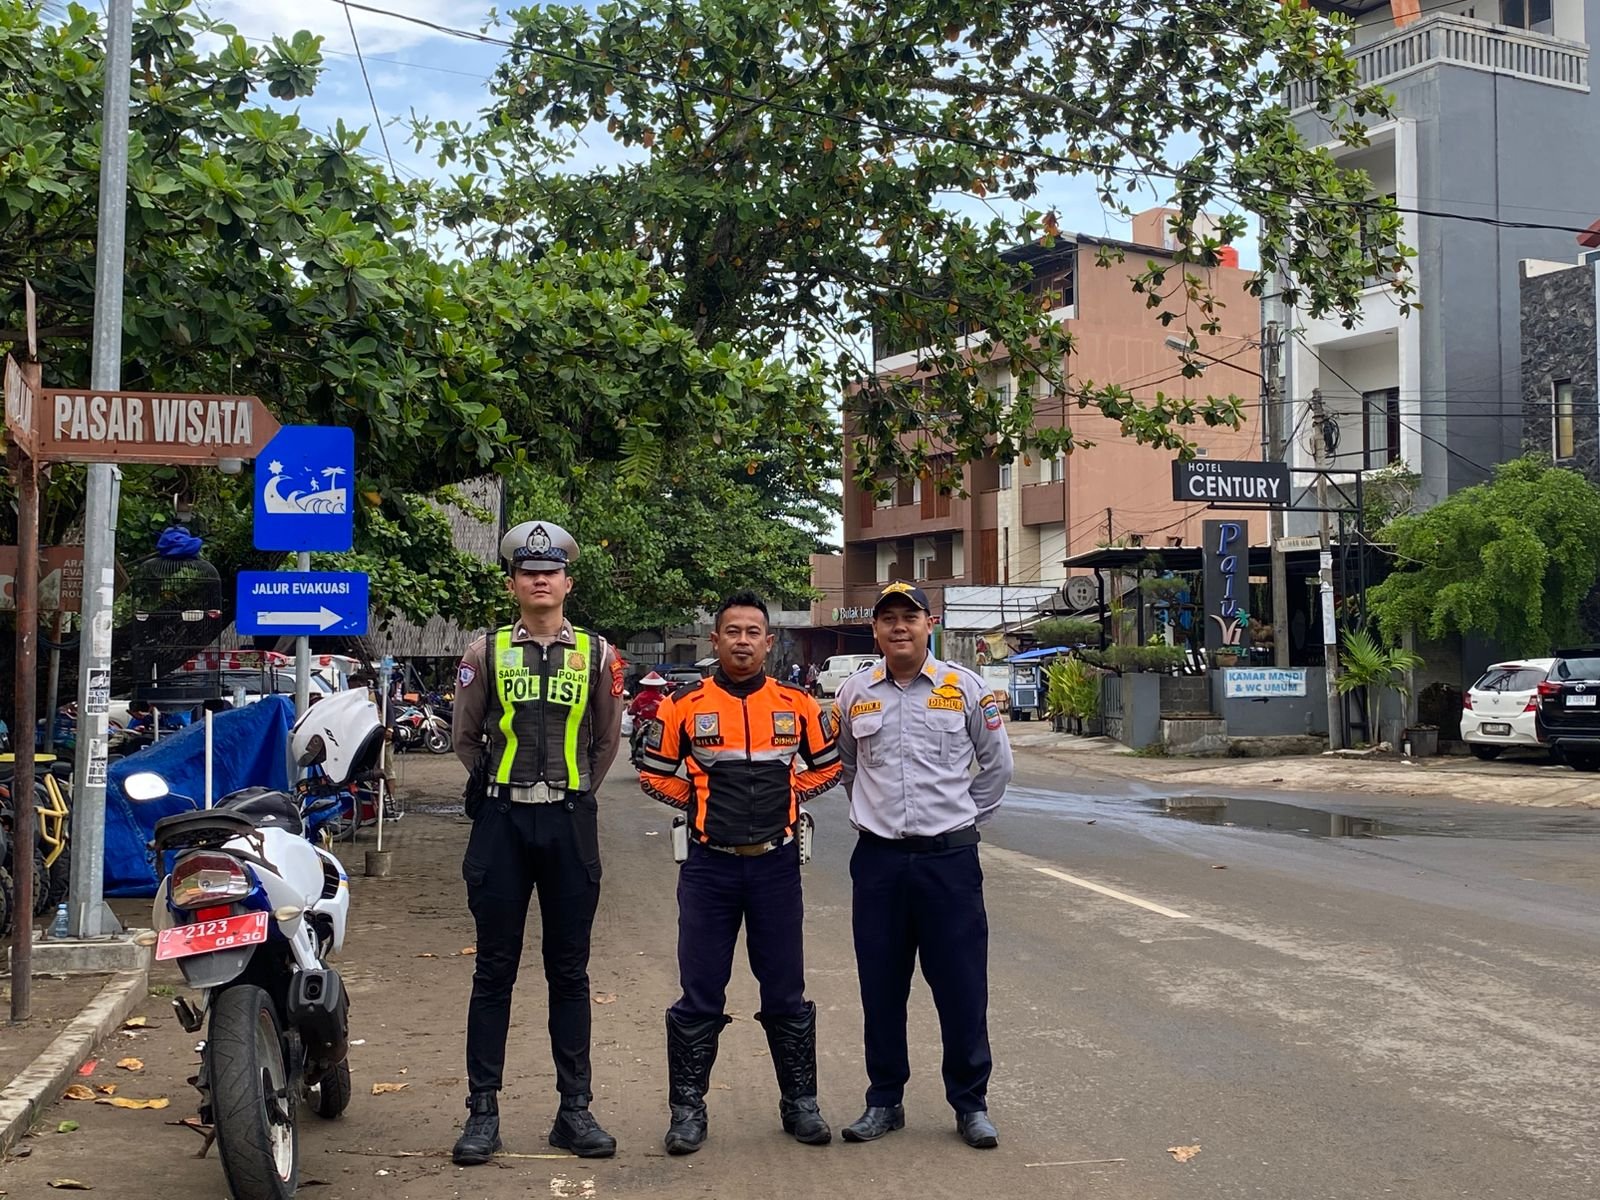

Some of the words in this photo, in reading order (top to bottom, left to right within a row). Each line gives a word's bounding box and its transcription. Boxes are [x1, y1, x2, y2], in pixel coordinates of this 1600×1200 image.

[54, 395, 144, 442] PASAR
[152, 398, 252, 445] WISATA
[1188, 462, 1222, 473] HOTEL
[1188, 475, 1280, 498] CENTURY
[63, 559, 84, 568] ARA
[62, 568, 83, 577] EVA
[61, 581, 83, 589] EVAC
[251, 582, 290, 595] JALUR
[291, 582, 350, 594] EVAKUASI
[62, 590, 82, 598] ROU
[498, 668, 528, 679] SADAM
[558, 670, 588, 683] POLRI
[1229, 672, 1265, 681] KAMAR
[1268, 672, 1303, 680] MANDI
[1235, 684, 1242, 692] &
[1245, 683, 1262, 692] WC
[1264, 683, 1297, 692] UMUM
[774, 736, 797, 746] DISHU
[185, 920, 228, 939] 2123
